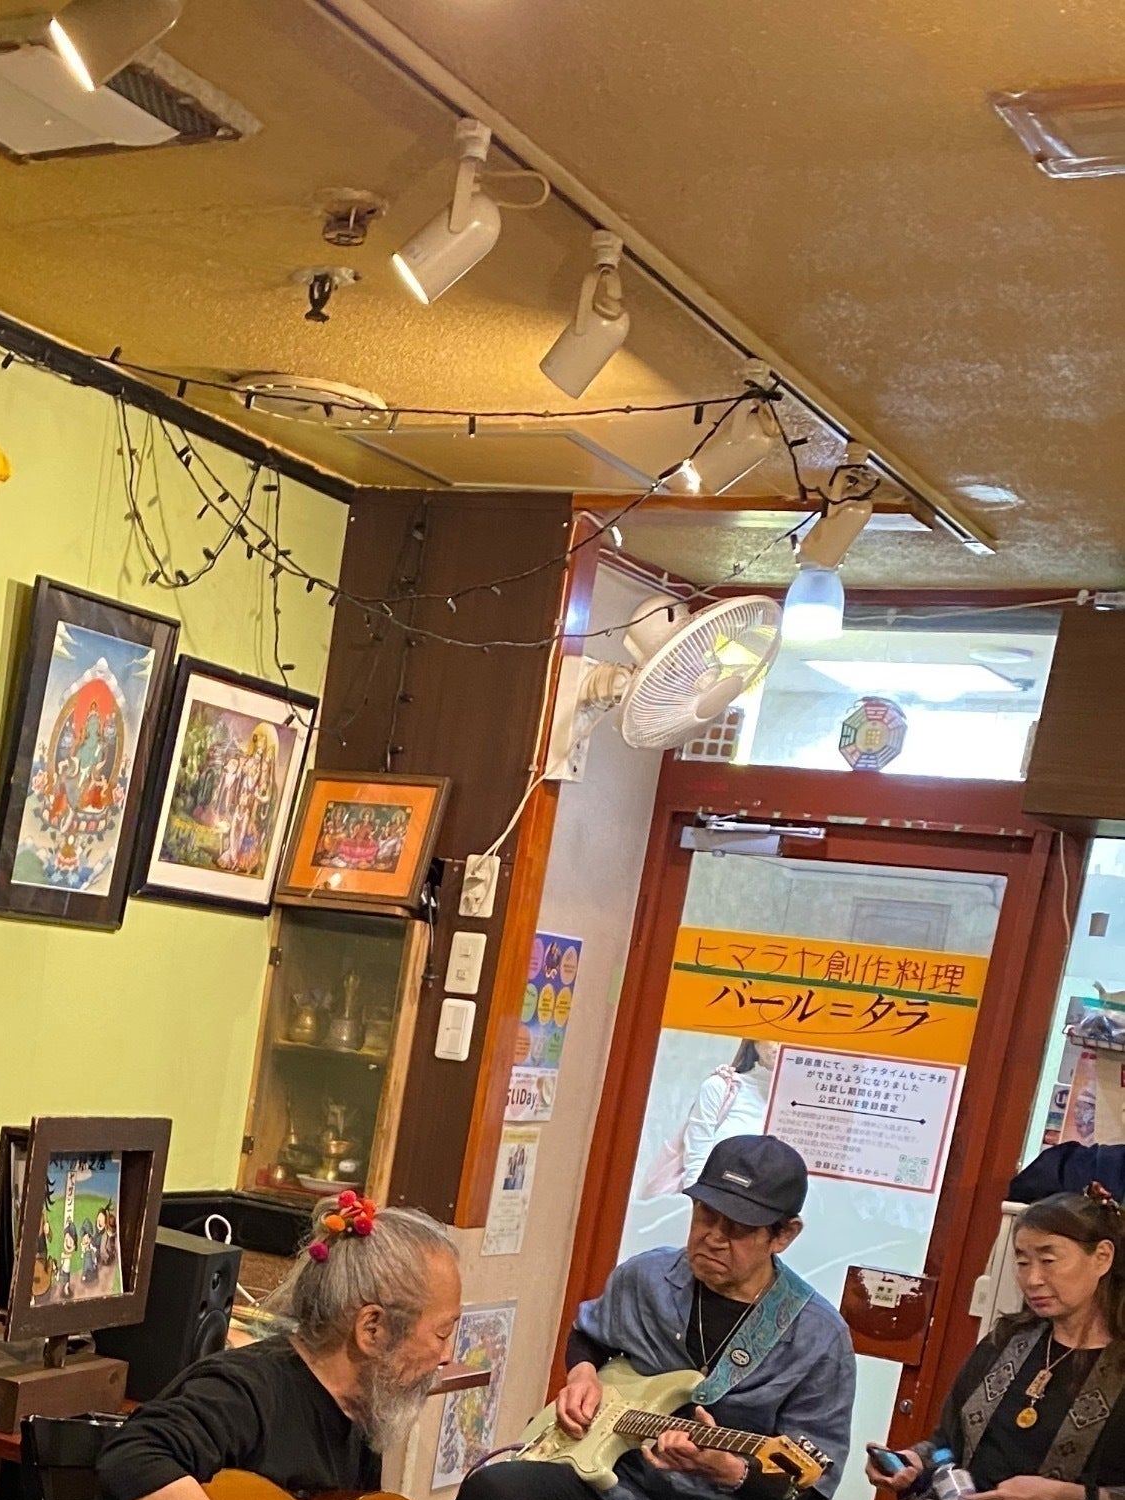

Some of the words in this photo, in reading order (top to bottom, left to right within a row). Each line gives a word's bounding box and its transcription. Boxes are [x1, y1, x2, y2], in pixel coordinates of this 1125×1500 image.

[694, 936, 966, 995] ヒマラヤ創作料理
[786, 1055, 948, 1084] 一部座席にて、ランチタイムもご予約
[806, 1069, 921, 1093] ができるようになりました
[818, 1094, 899, 1114] 公式LINE登録限定
